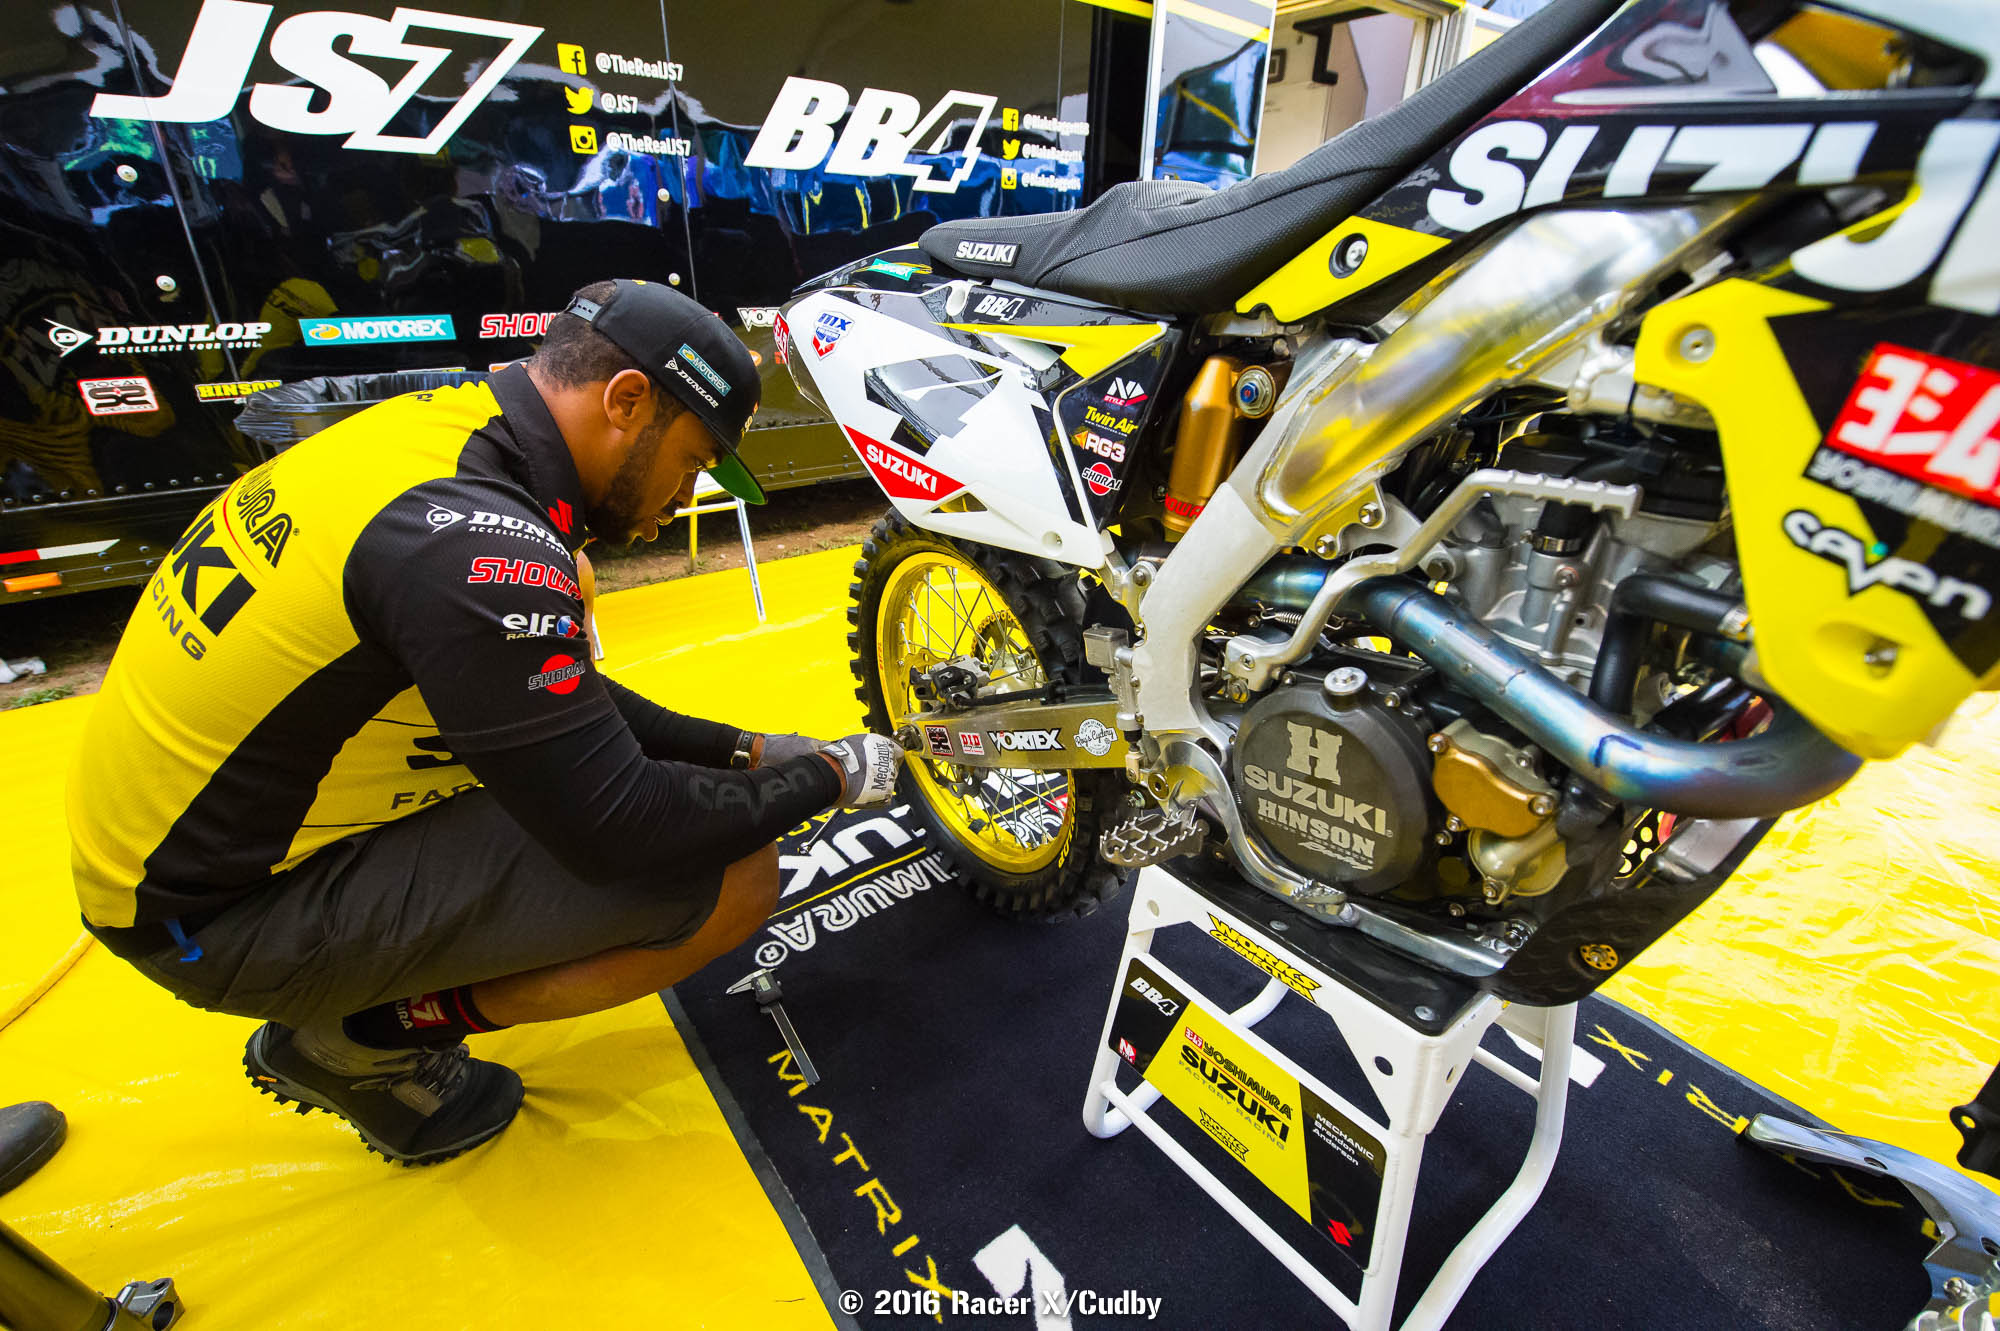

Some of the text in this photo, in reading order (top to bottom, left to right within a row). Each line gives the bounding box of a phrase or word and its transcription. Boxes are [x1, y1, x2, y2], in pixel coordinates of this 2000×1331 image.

[90, 0, 546, 155] JS7
[595, 52, 684, 82] @TheRealJS7
[601, 92, 638, 114] @JS7
[606, 131, 692, 156] @TheRealJS7
[744, 76, 998, 194] BB4
[955, 240, 1017, 263] SUZUKI
[973, 294, 1026, 321] BB4
[96, 322, 272, 346] DUNLOP
[341, 319, 446, 340] MOTOREX
[100, 344, 182, 354] ACCELERATE
[189, 342, 221, 351] YOUR
[677, 369, 720, 409] DUNLOP
[692, 358, 728, 393] MOTOREX
[1085, 406, 1139, 434] Twin Air
[1085, 432, 1126, 463] RG3
[866, 443, 938, 494] SUZUKI
[1082, 467, 1122, 490] SHORAI
[469, 526, 542, 543] ACCELERATE
[503, 613, 556, 636] elf
[528, 660, 586, 691] SHORAI
[960, 734, 981, 746] DID
[988, 729, 1064, 753] VORTEX
[1286, 721, 1343, 785] H
[871, 740, 891, 793] Mechanix
[1244, 764, 1388, 837] SUZUKI
[1257, 797, 1376, 860] HINSON
[1207, 912, 1322, 991] WORKS
[1130, 976, 1180, 1017] BB4
[1181, 1044, 1289, 1143] SUZUKI
[1203, 1041, 1292, 1120] YOSHIMURA
[1178, 1060, 1286, 1150] FACTORY RACING
[1312, 1128, 1359, 1166] Anderson
[1314, 1120, 1356, 1155] Brandon
[1316, 1113, 1374, 1160] MECHANIC
[768, 1048, 965, 1325] MATRIX
